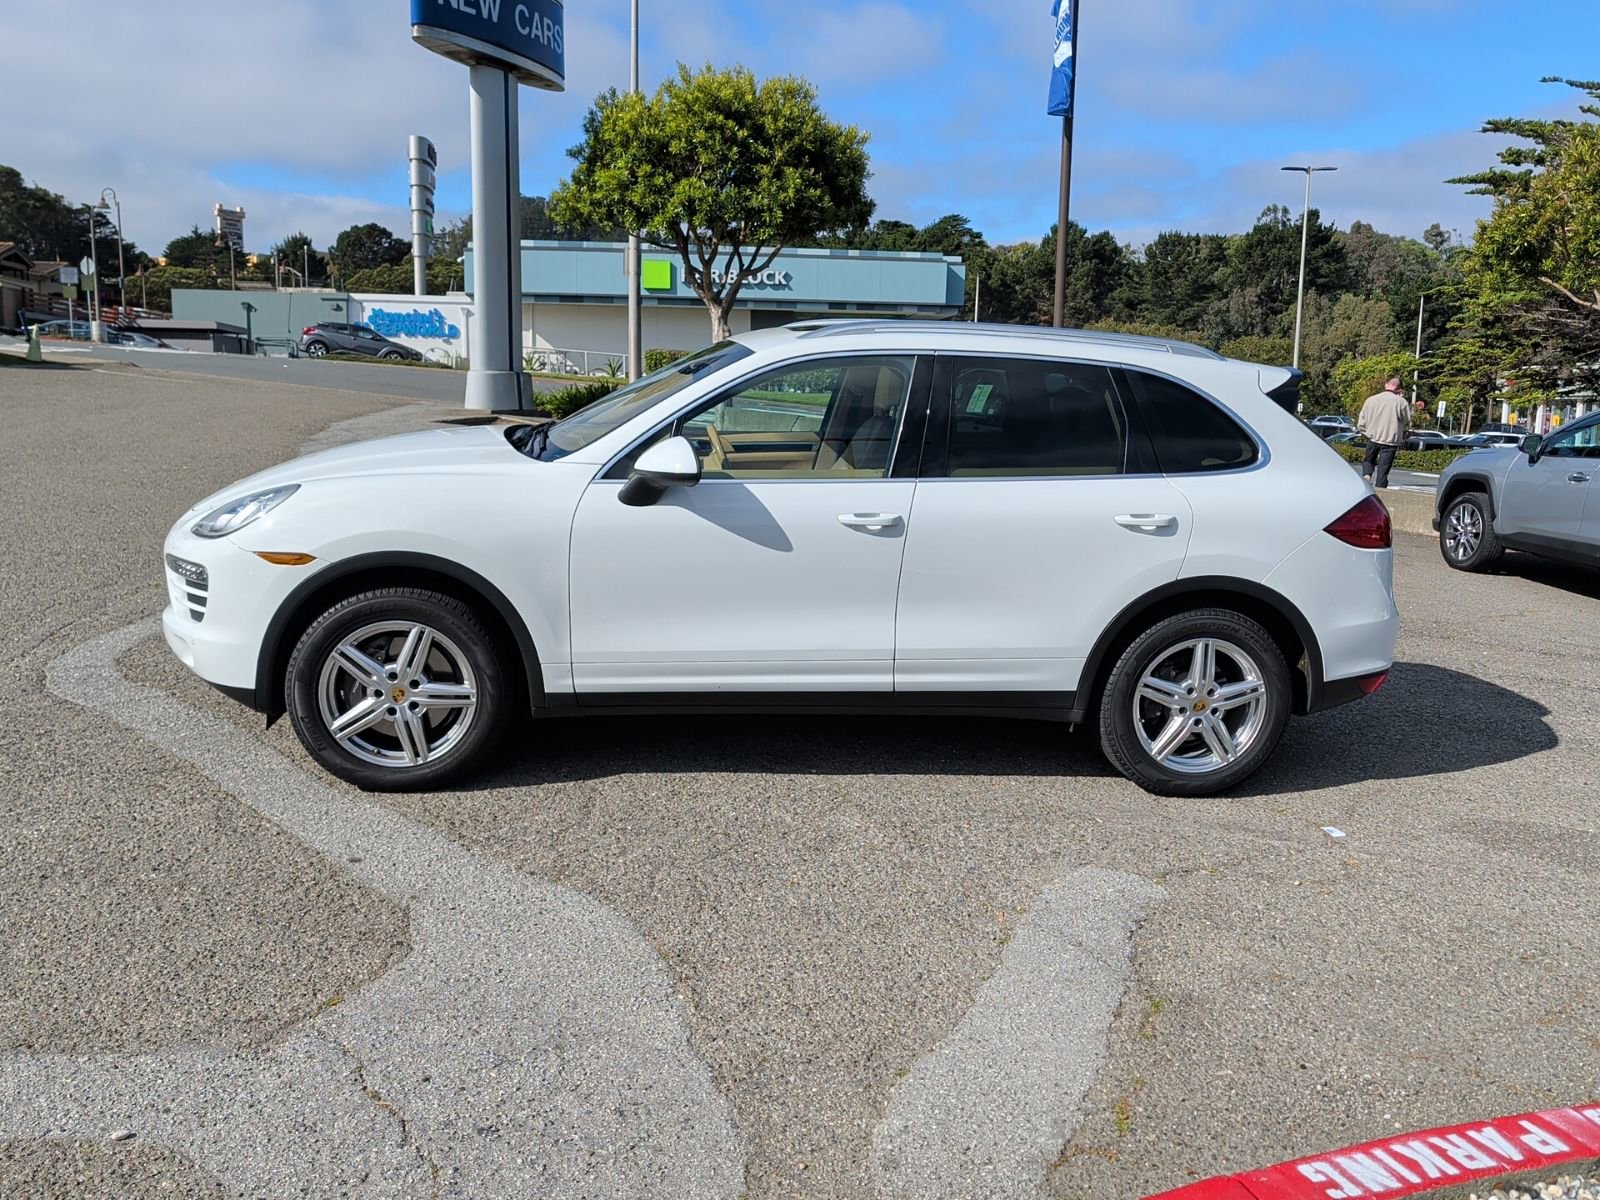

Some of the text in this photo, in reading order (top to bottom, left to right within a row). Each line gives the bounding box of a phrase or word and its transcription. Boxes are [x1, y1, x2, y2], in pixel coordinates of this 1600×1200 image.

[438, 0, 563, 54] EW CARS
[354, 321, 461, 339] EEPWORLD
[1296, 1119, 1570, 1199] PARKING
